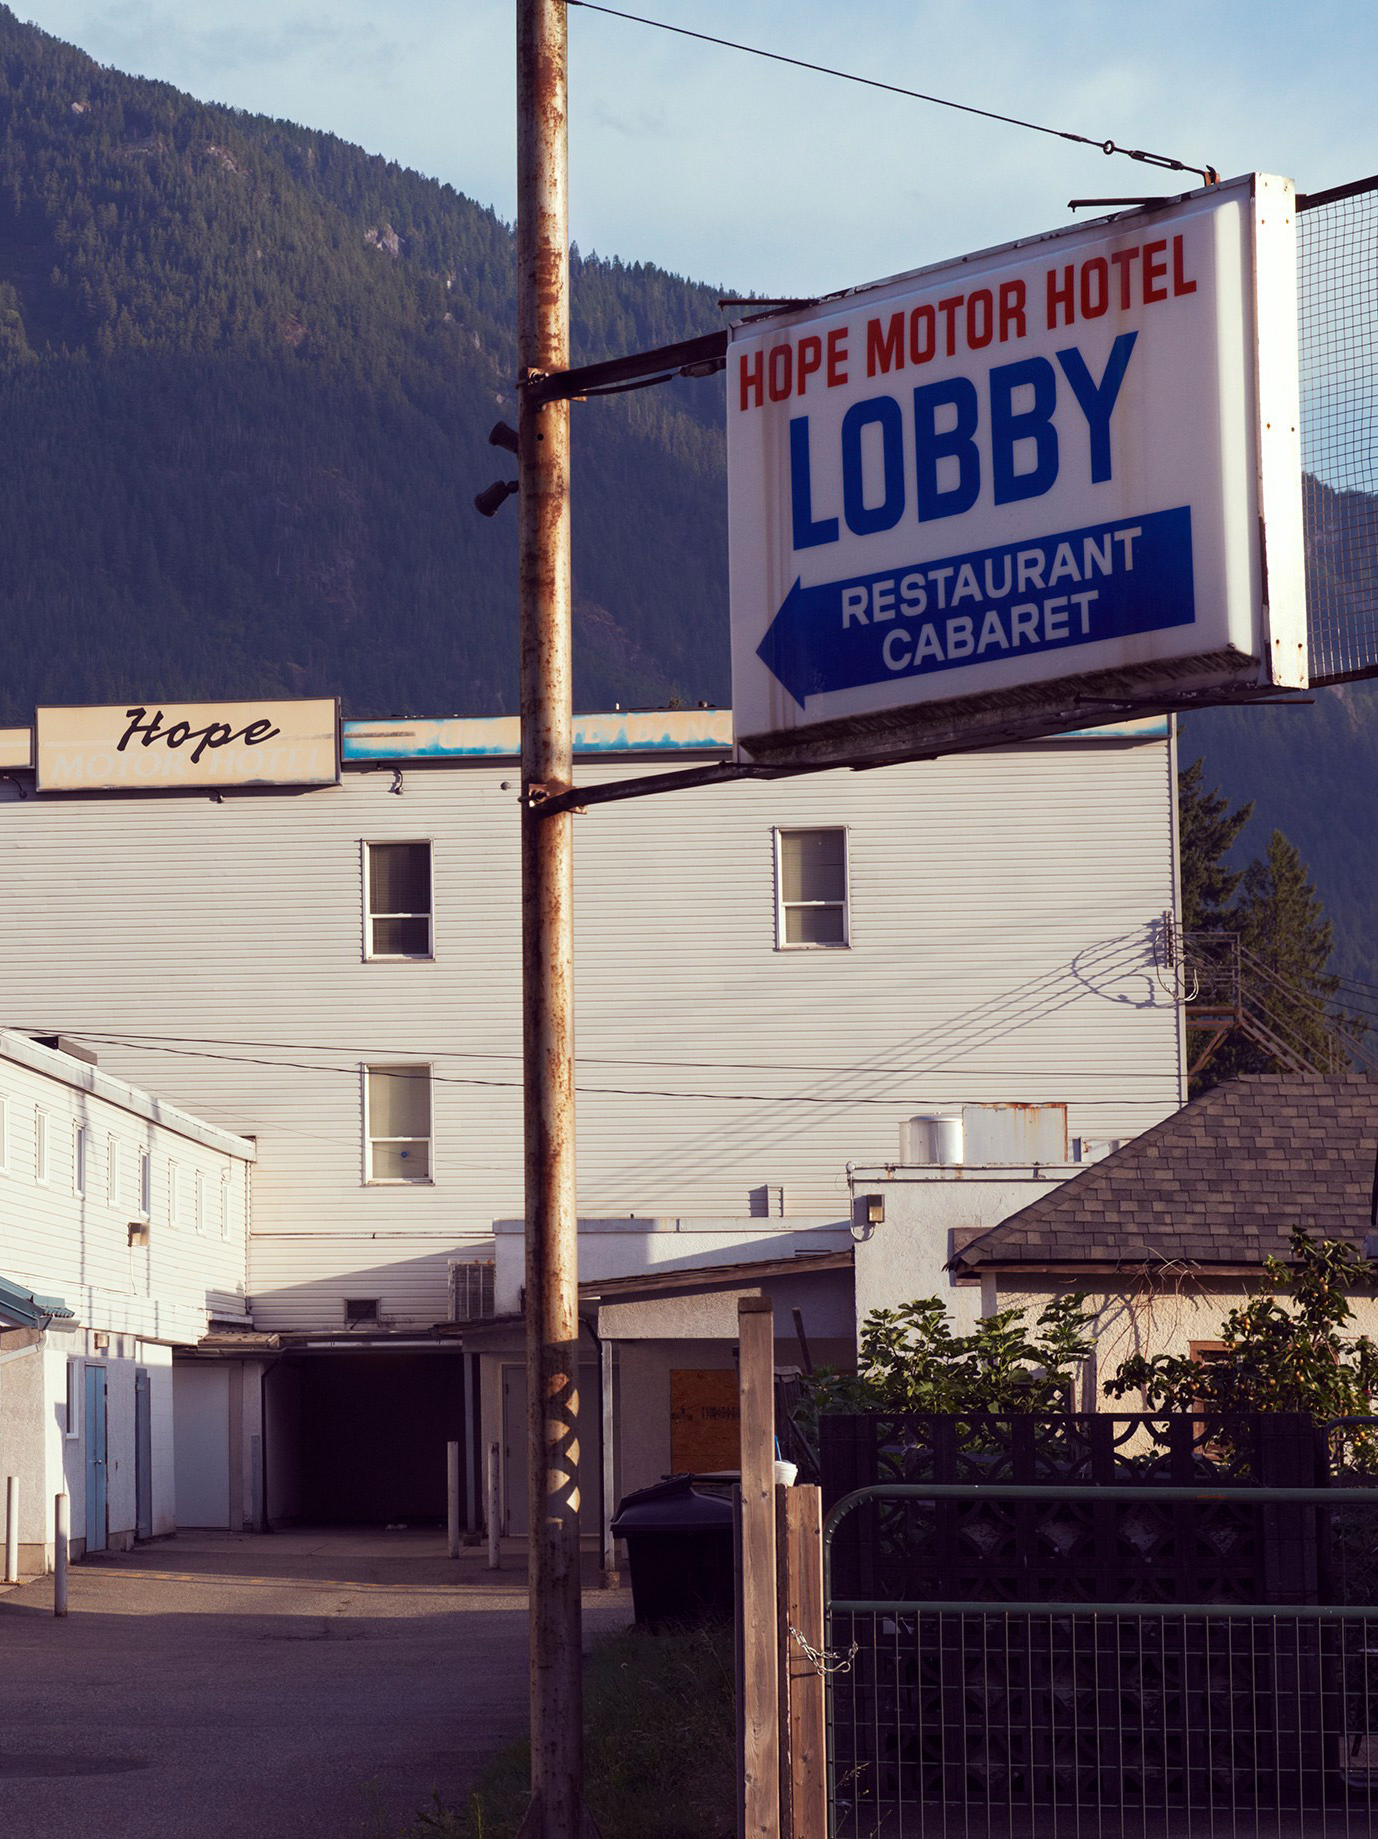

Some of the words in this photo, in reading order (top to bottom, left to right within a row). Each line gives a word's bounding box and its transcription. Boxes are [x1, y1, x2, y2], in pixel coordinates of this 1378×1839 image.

[740, 327, 849, 412] HOPE
[866, 279, 1027, 378] MOTOR
[1046, 234, 1198, 330] HOTEL
[789, 330, 1140, 552] LOBBY
[841, 526, 1143, 629] RESTAURANT
[882, 590, 1100, 672] CABARET
[51, 750, 187, 780] MOTOR
[206, 746, 324, 776] HOTEL
[117, 706, 281, 764] Hope
